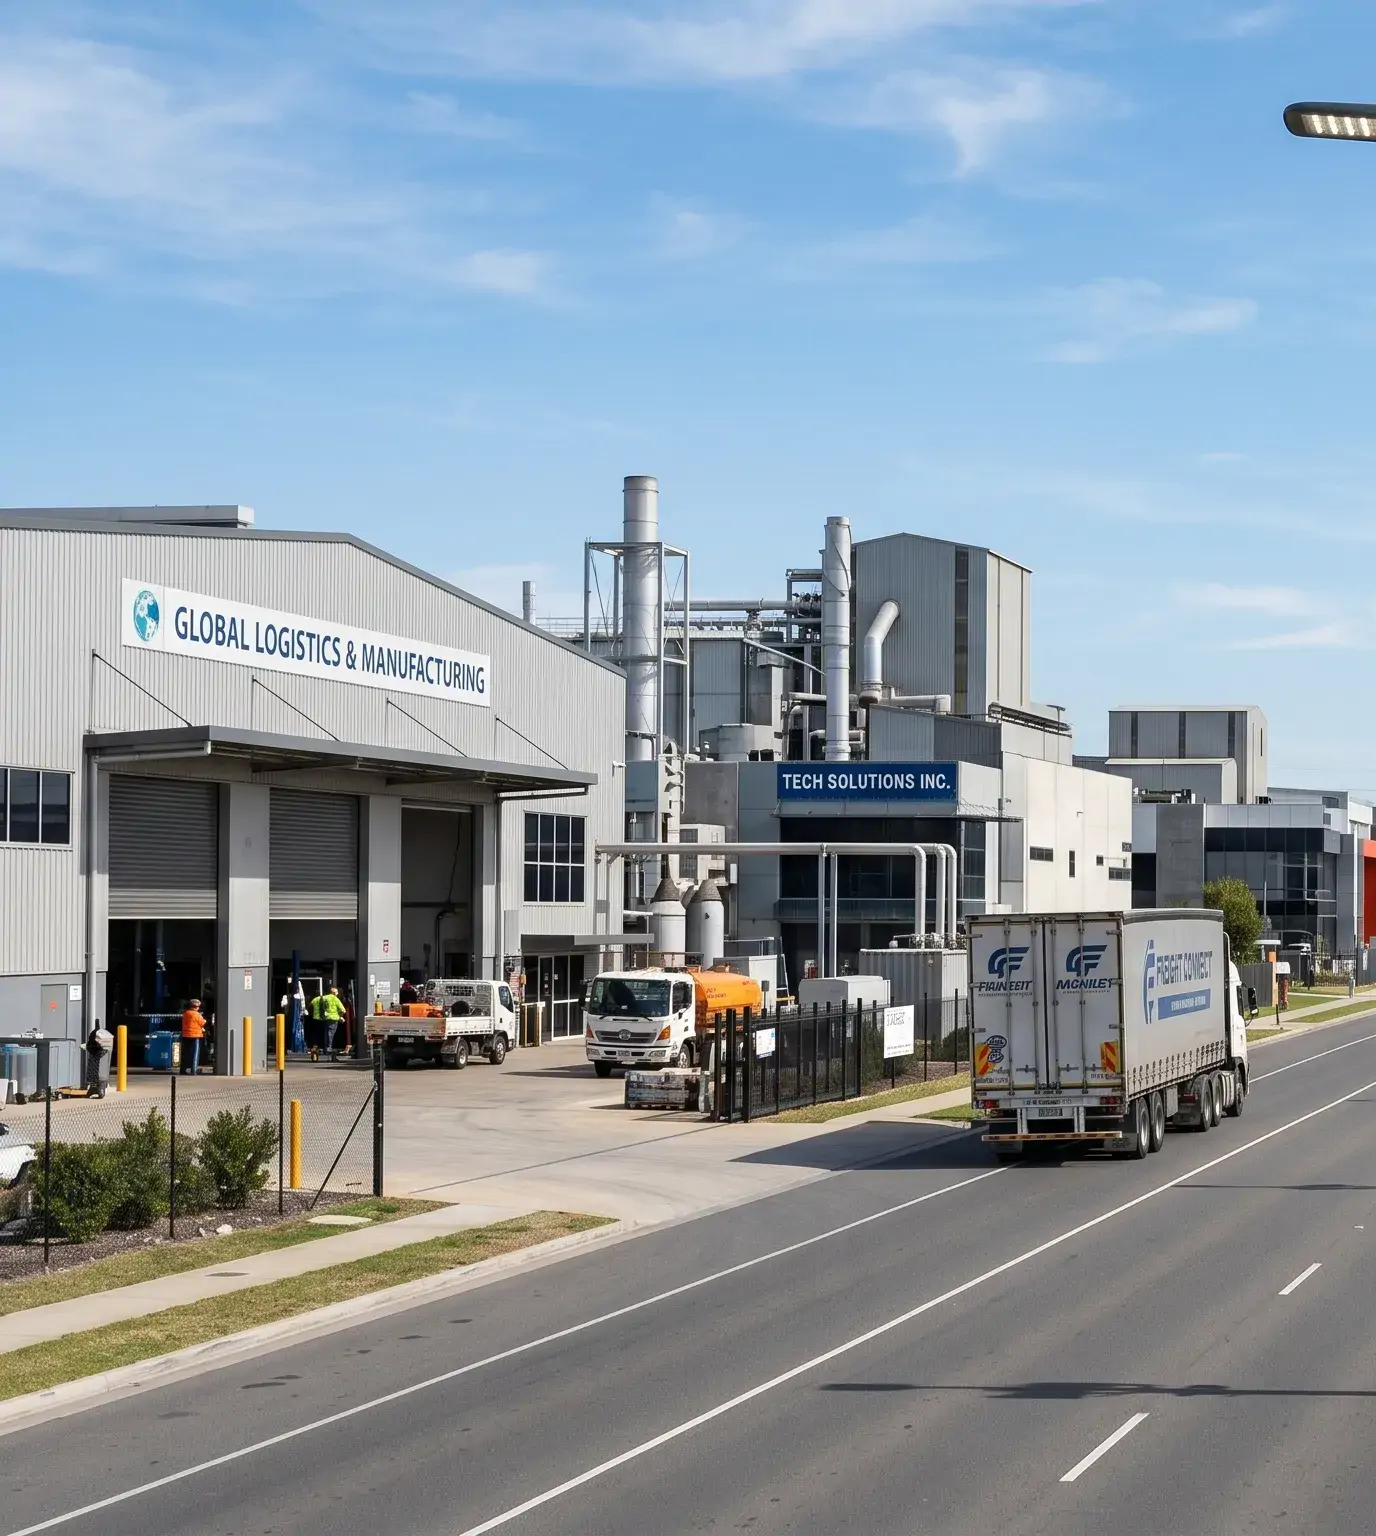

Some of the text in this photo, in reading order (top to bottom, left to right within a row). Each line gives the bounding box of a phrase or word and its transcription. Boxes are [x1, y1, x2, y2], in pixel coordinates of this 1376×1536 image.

[174, 606, 485, 694] GLOBAL LOGISTICS & MANUFACTURING
[782, 773, 951, 789] TECH SOLUTIONS INC.
